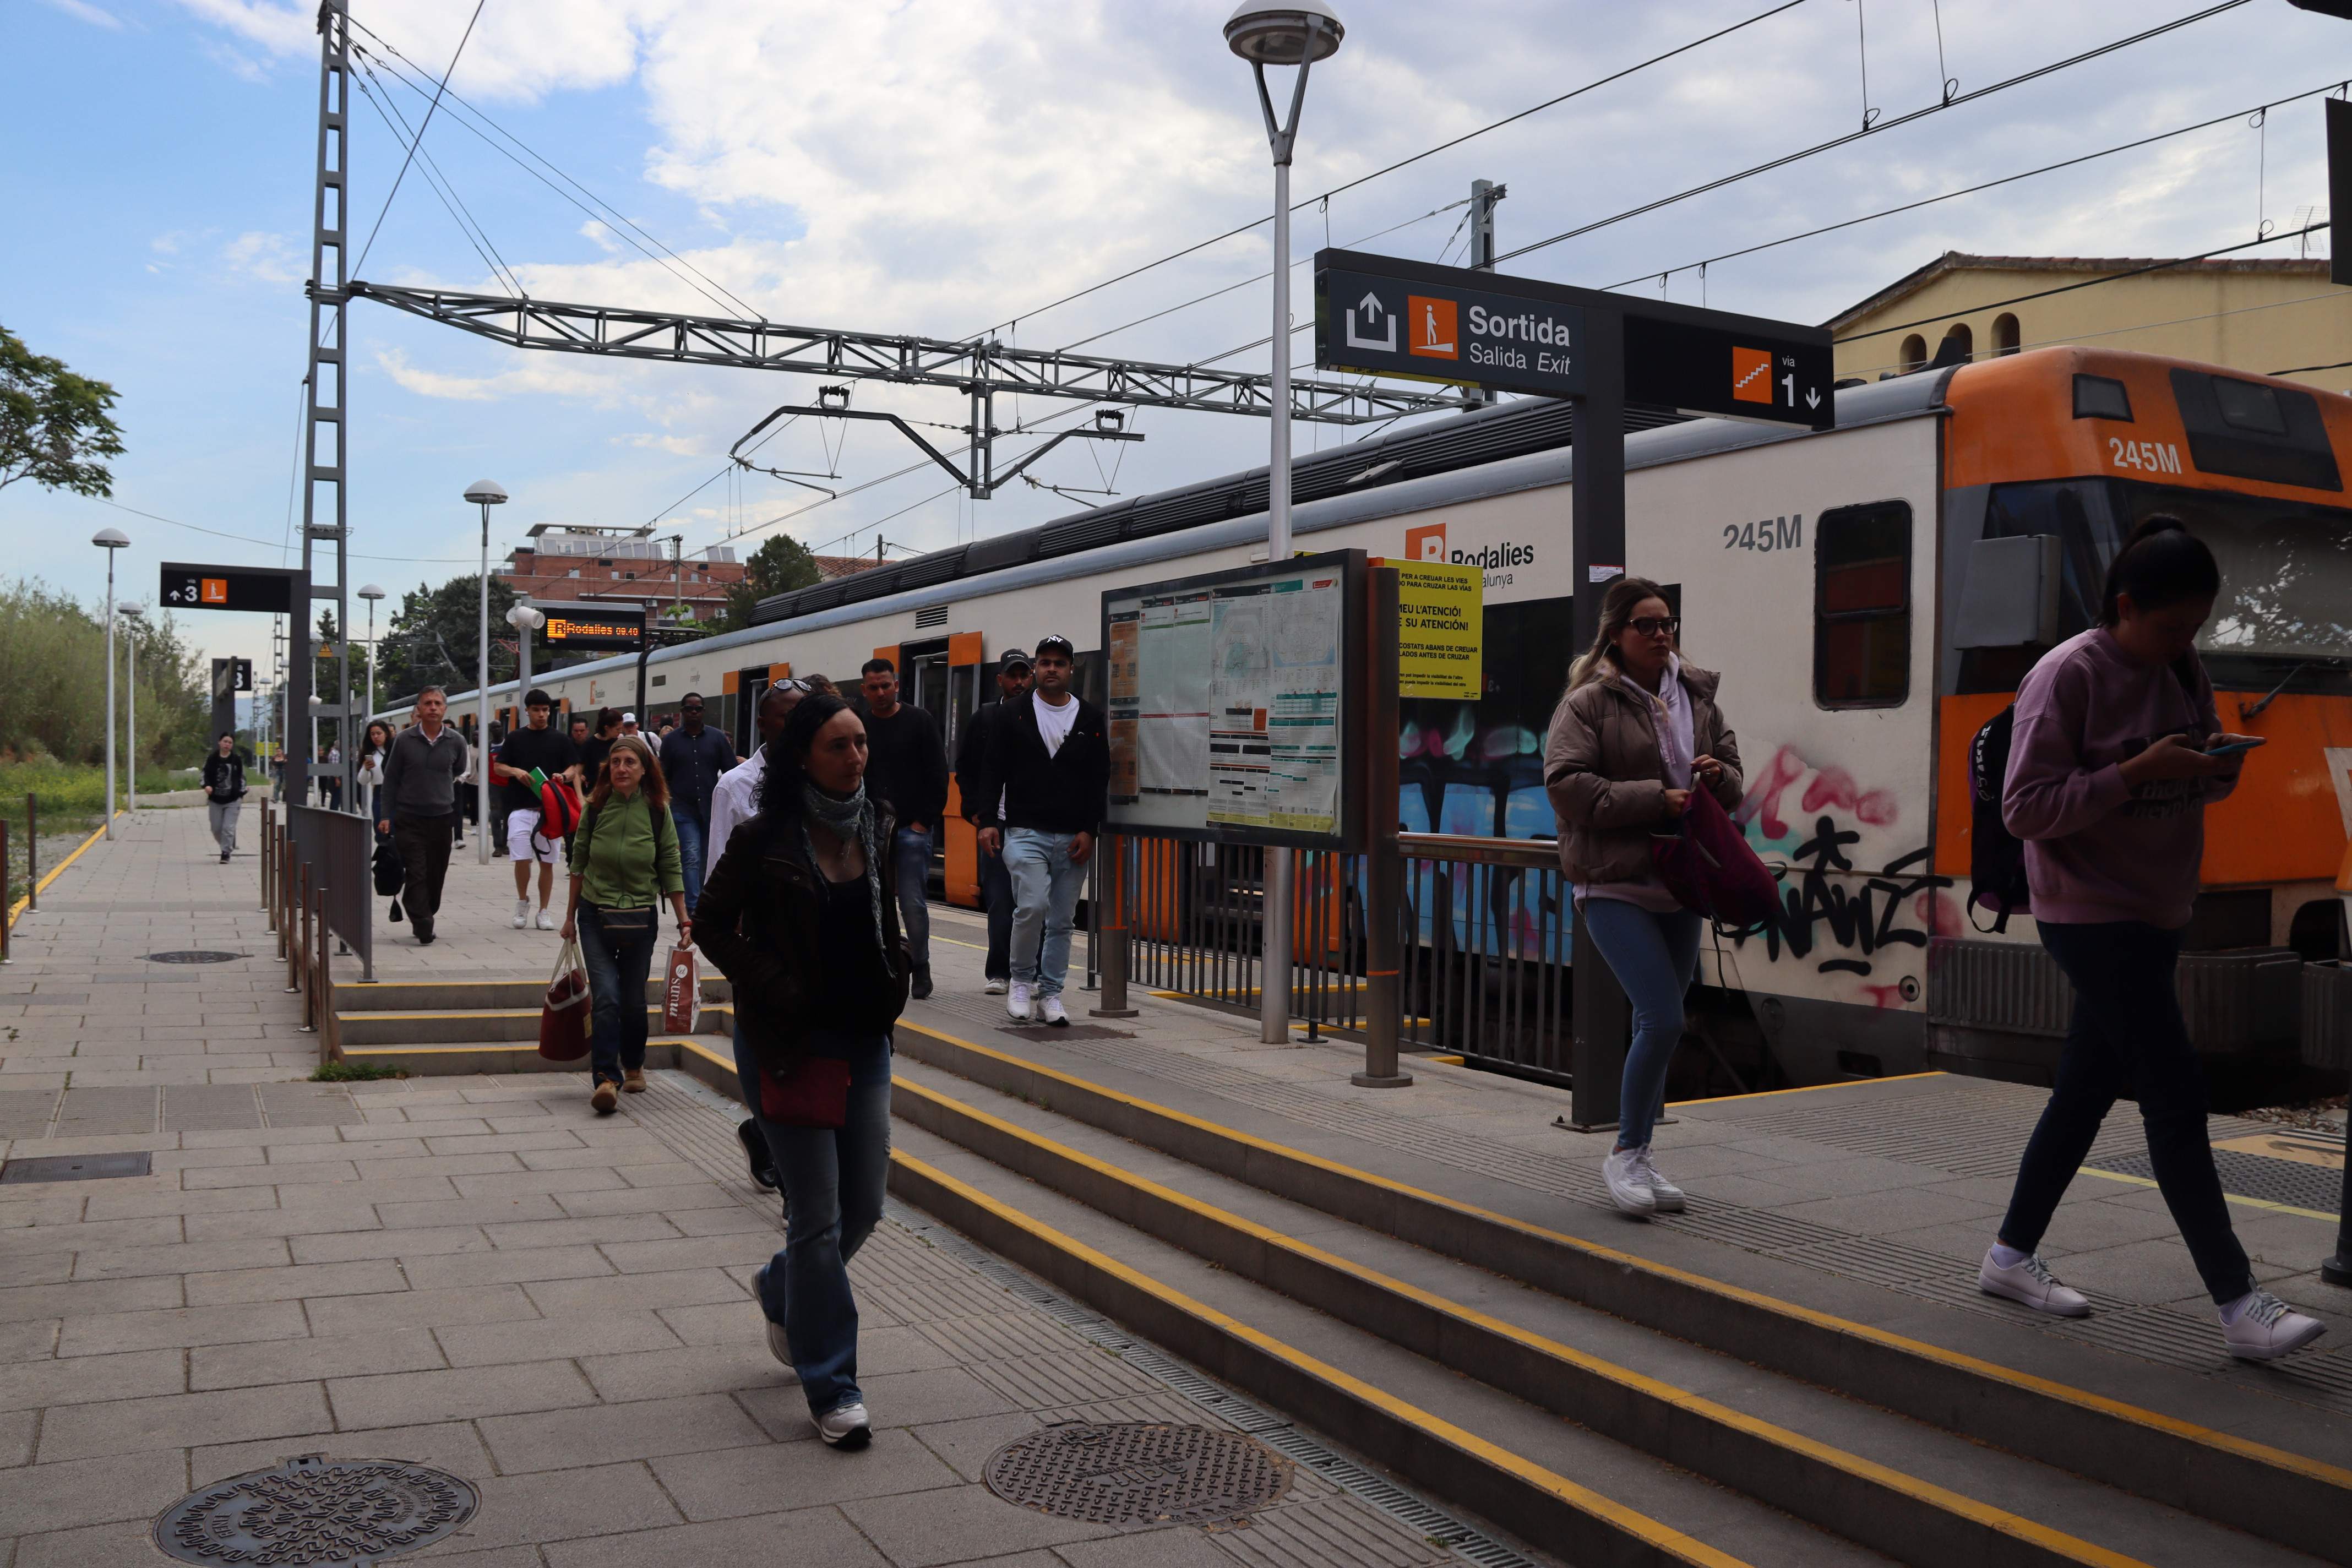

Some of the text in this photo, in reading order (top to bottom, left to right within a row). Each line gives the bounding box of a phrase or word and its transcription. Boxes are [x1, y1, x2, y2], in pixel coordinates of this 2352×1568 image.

[1468, 305, 1570, 347] Sortida
[1469, 341, 1571, 375] Salida Exit
[1782, 354, 1796, 368] via
[1781, 373, 1794, 407] 1
[2109, 437, 2182, 475] 245M
[1723, 514, 1802, 552] 245M
[1451, 542, 1534, 569] Rodalies
[184, 585, 198, 602] 3
[1483, 571, 1513, 589] alunya
[567, 623, 613, 635] Rodalies
[1406, 617, 1418, 628] SU
[1420, 619, 1468, 631] ATENCIÓN!
[1108, 1464, 1188, 1487] adif
[212, 1511, 236, 1538] RENFE
